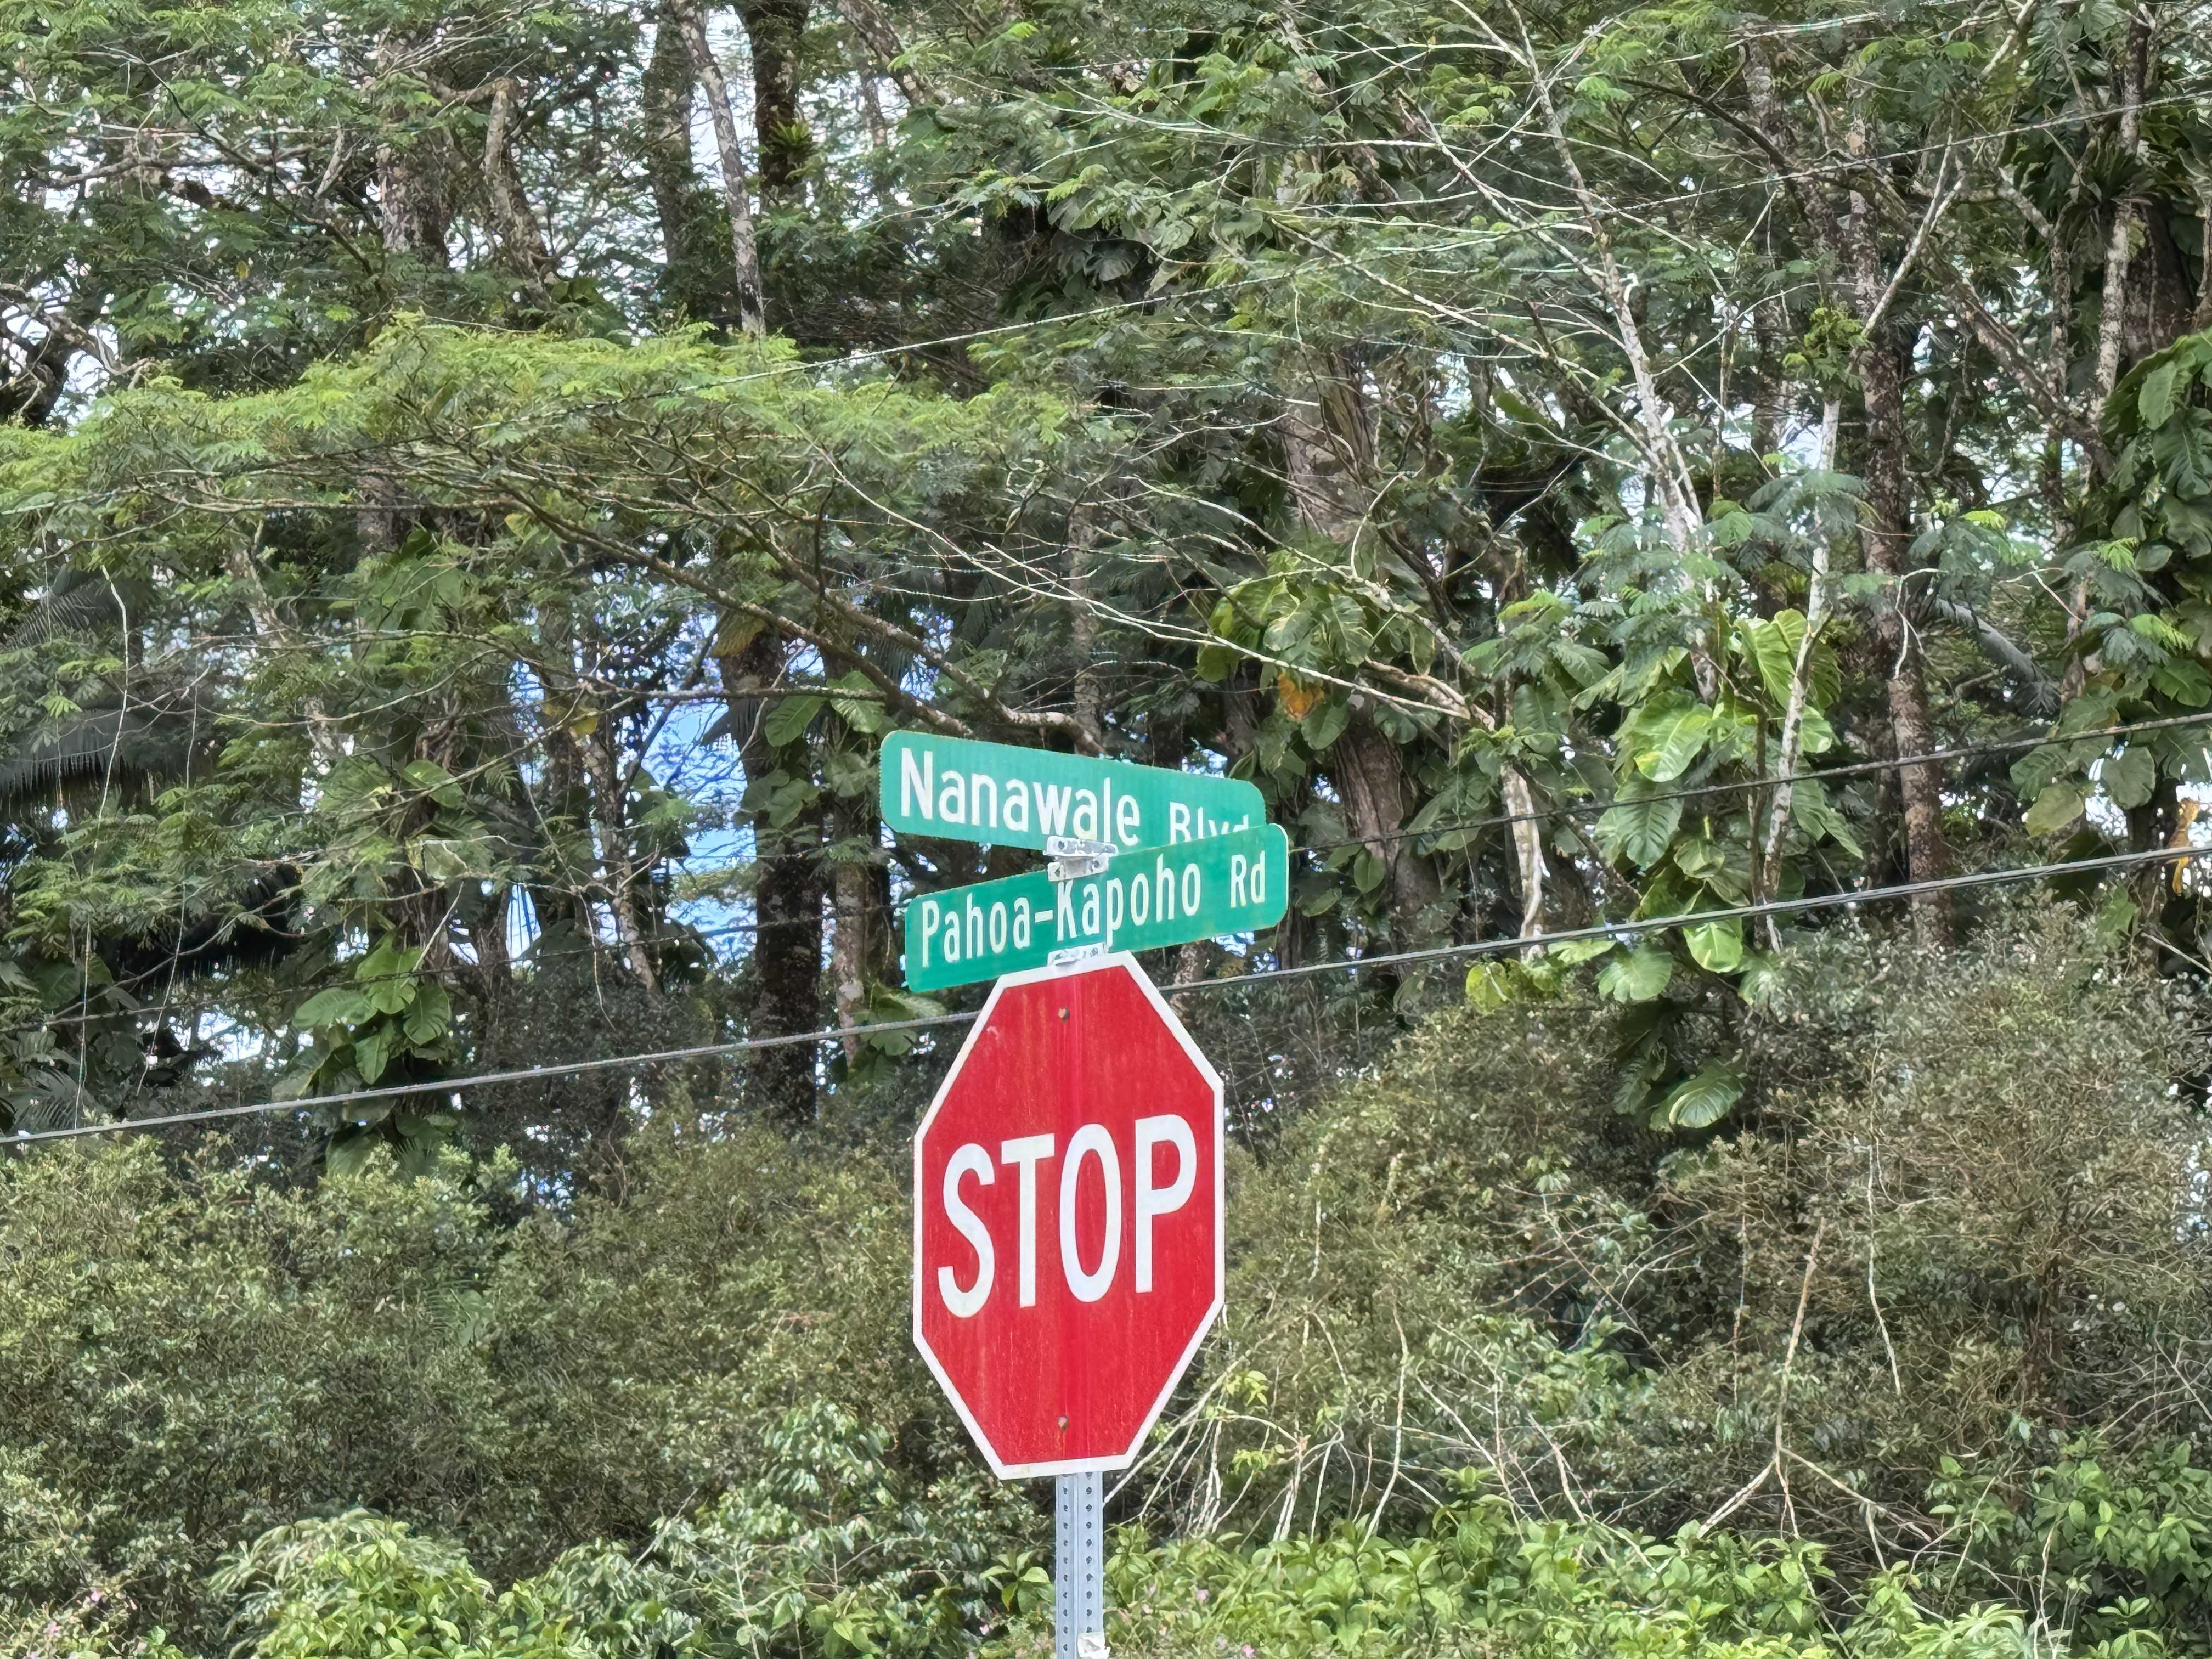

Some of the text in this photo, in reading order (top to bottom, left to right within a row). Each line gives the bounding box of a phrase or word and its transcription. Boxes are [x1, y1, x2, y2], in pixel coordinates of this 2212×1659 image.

[901, 747, 1140, 846] Nanawale
[922, 850, 1265, 967] Pahoa-Kapoho Rd
[938, 1114, 1197, 1318] STOP
